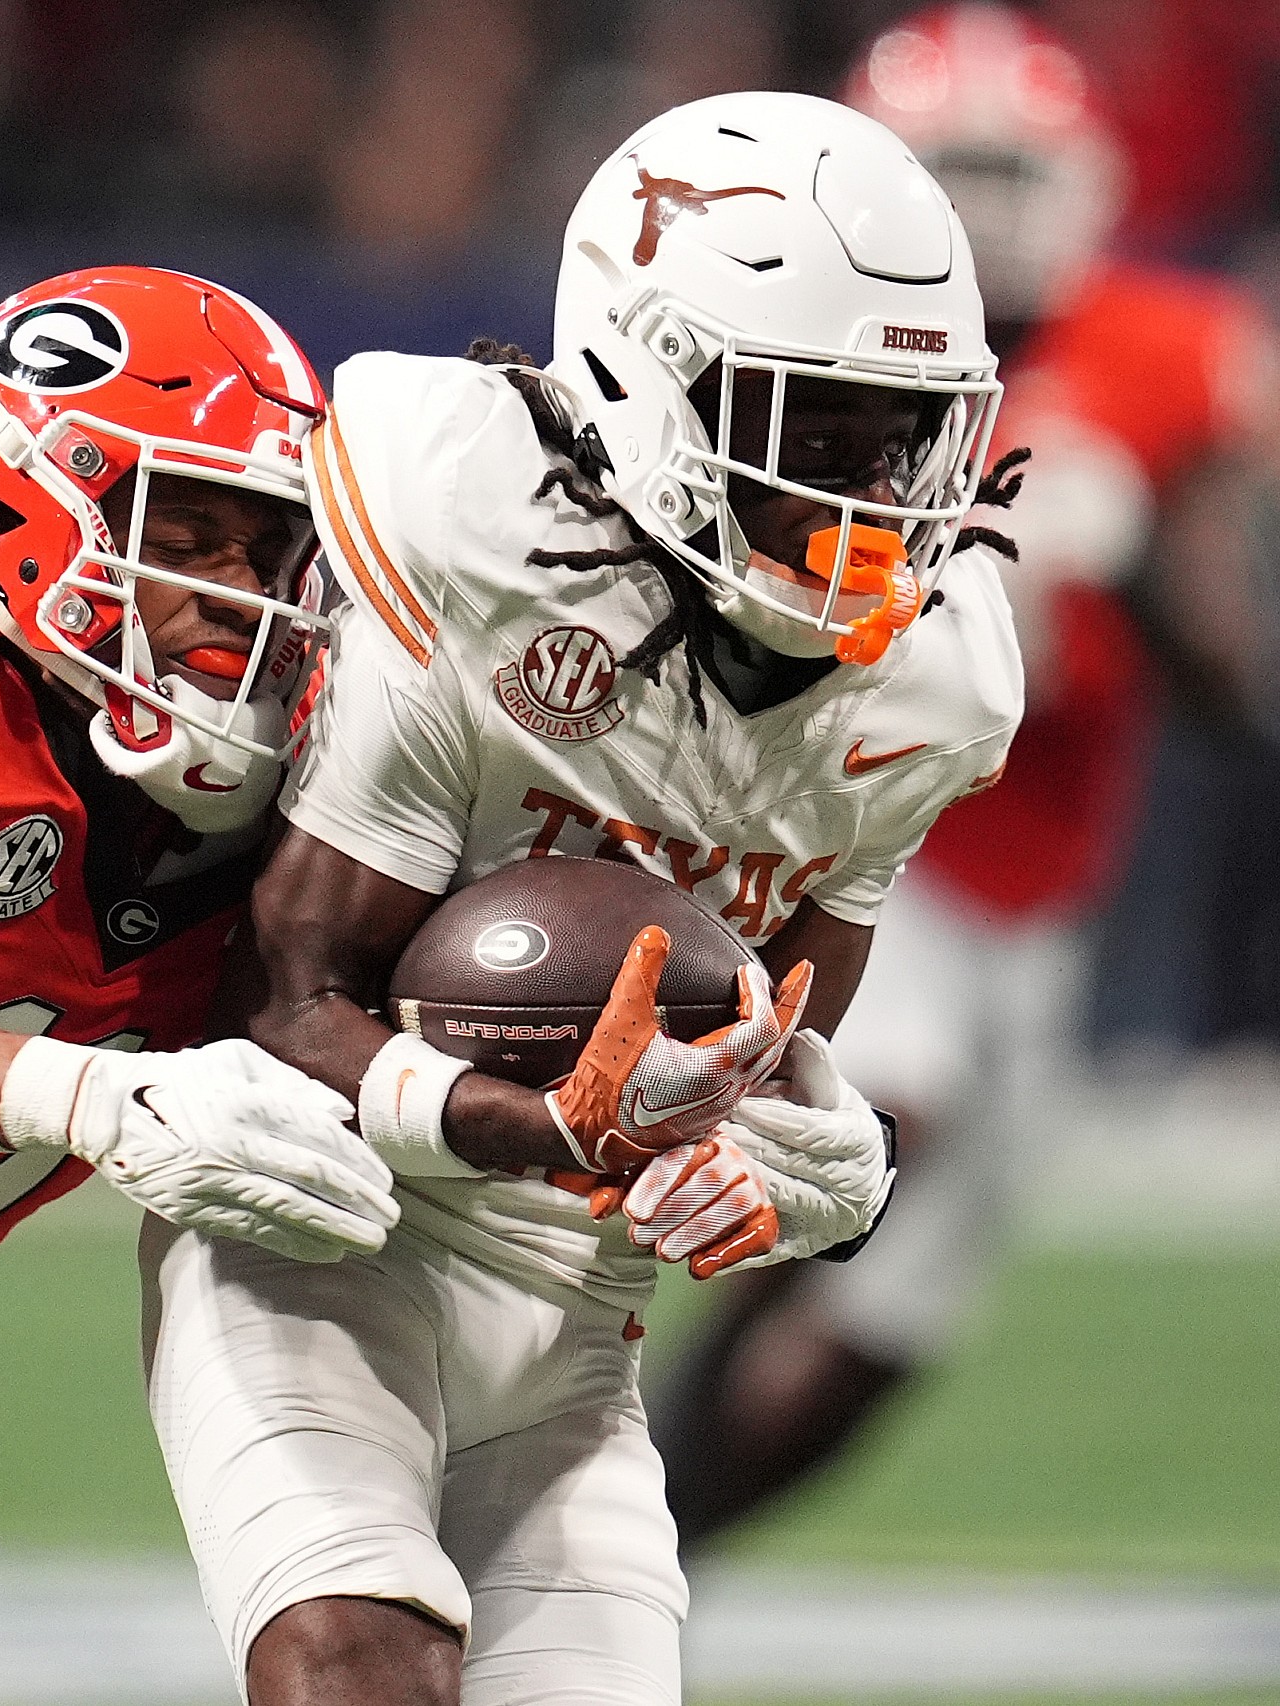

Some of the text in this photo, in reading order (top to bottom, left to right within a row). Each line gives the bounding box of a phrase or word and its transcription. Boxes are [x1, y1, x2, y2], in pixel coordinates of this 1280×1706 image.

[882, 325, 949, 353] HORNS
[527, 629, 613, 711] SEC
[503, 686, 601, 738] GRADUATE
[444, 1019, 579, 1041] VAPOR ELITE
